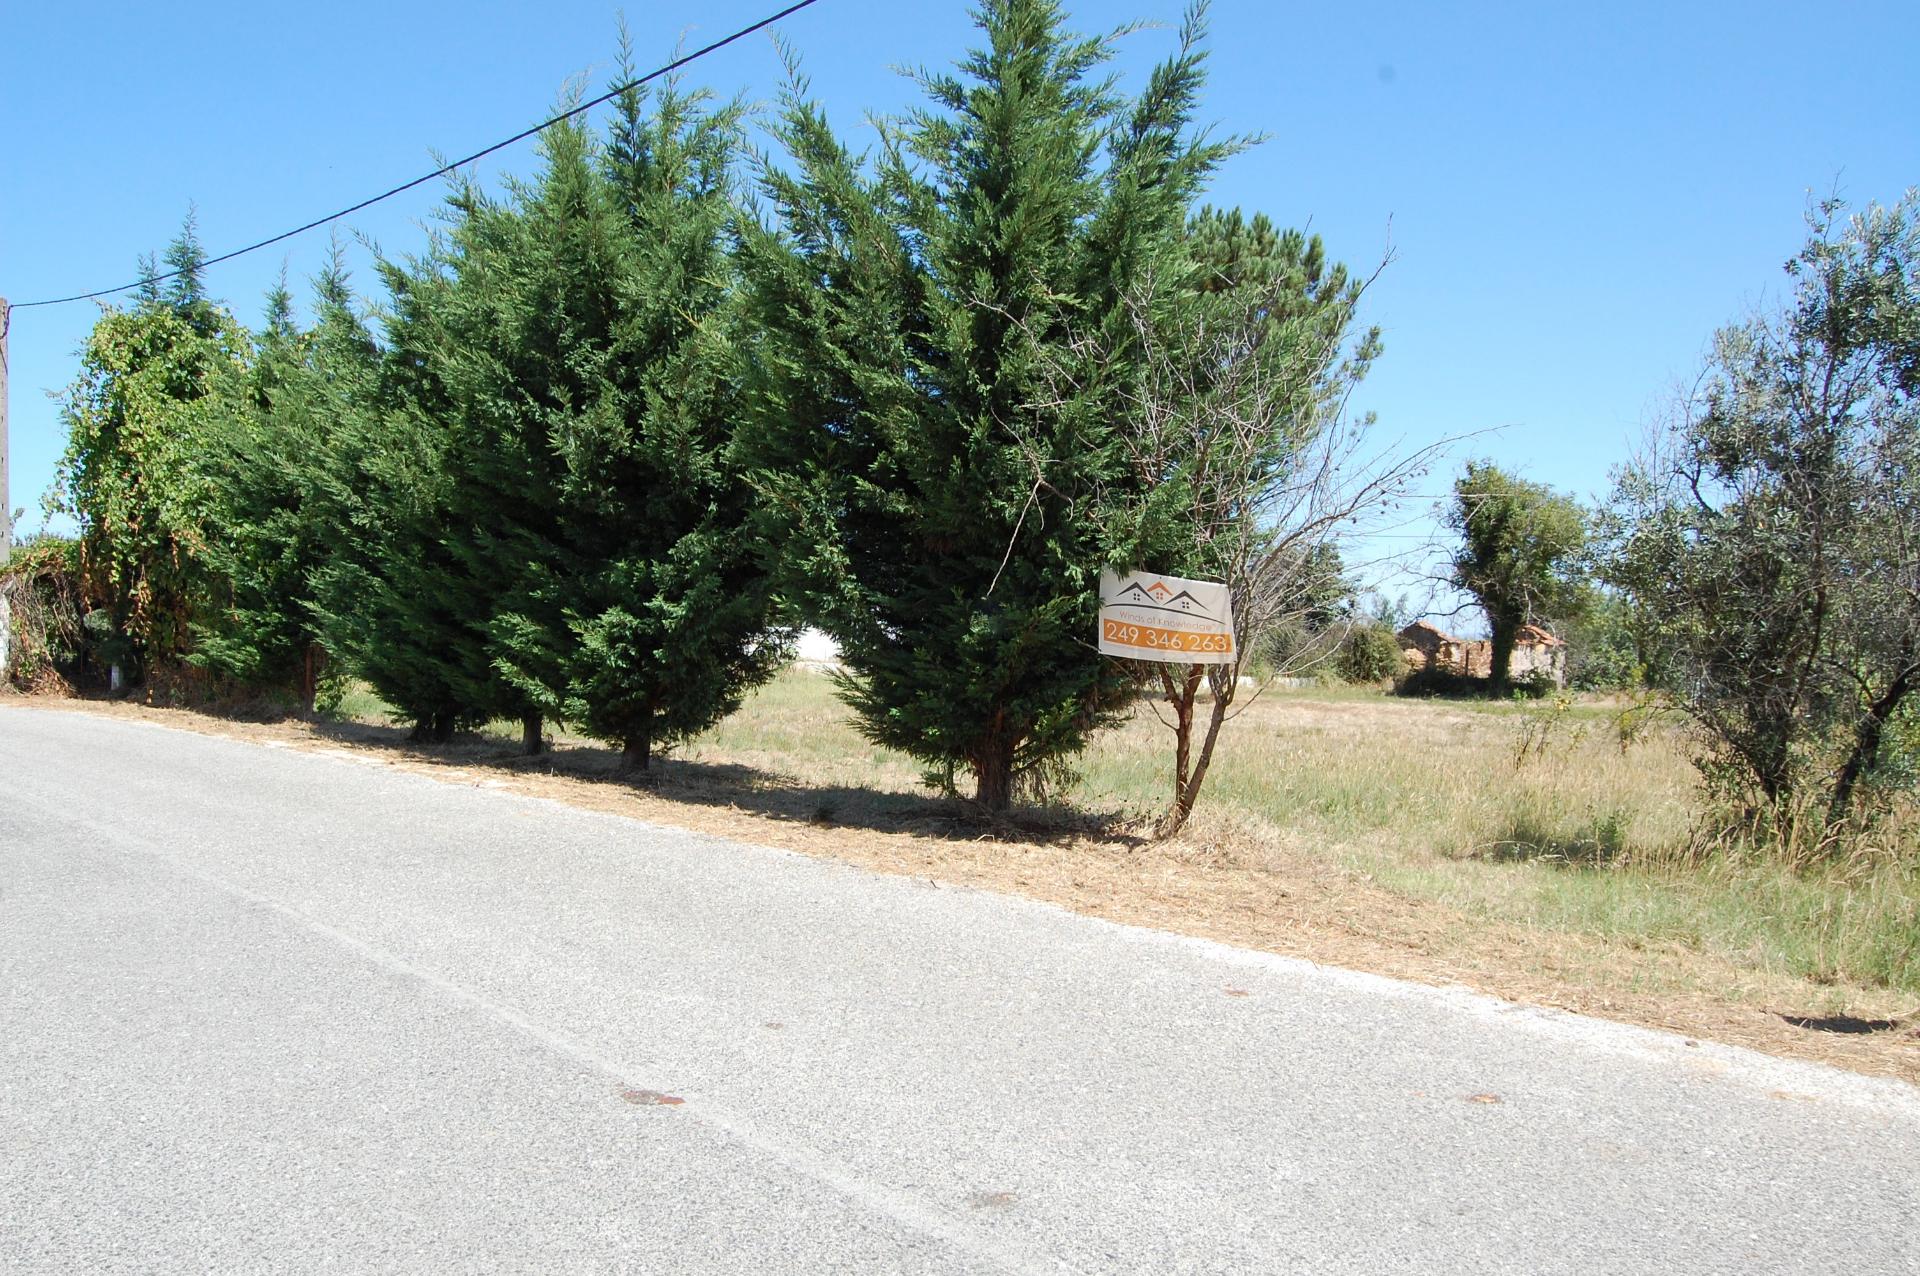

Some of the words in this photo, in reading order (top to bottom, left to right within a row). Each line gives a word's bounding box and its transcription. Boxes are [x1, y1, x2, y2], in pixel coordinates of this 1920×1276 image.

[1119, 611, 1145, 623] Winds
[1146, 616, 1156, 624] of
[1106, 622, 1139, 643] 249
[1146, 630, 1182, 649] 346
[1188, 635, 1227, 650] 263
